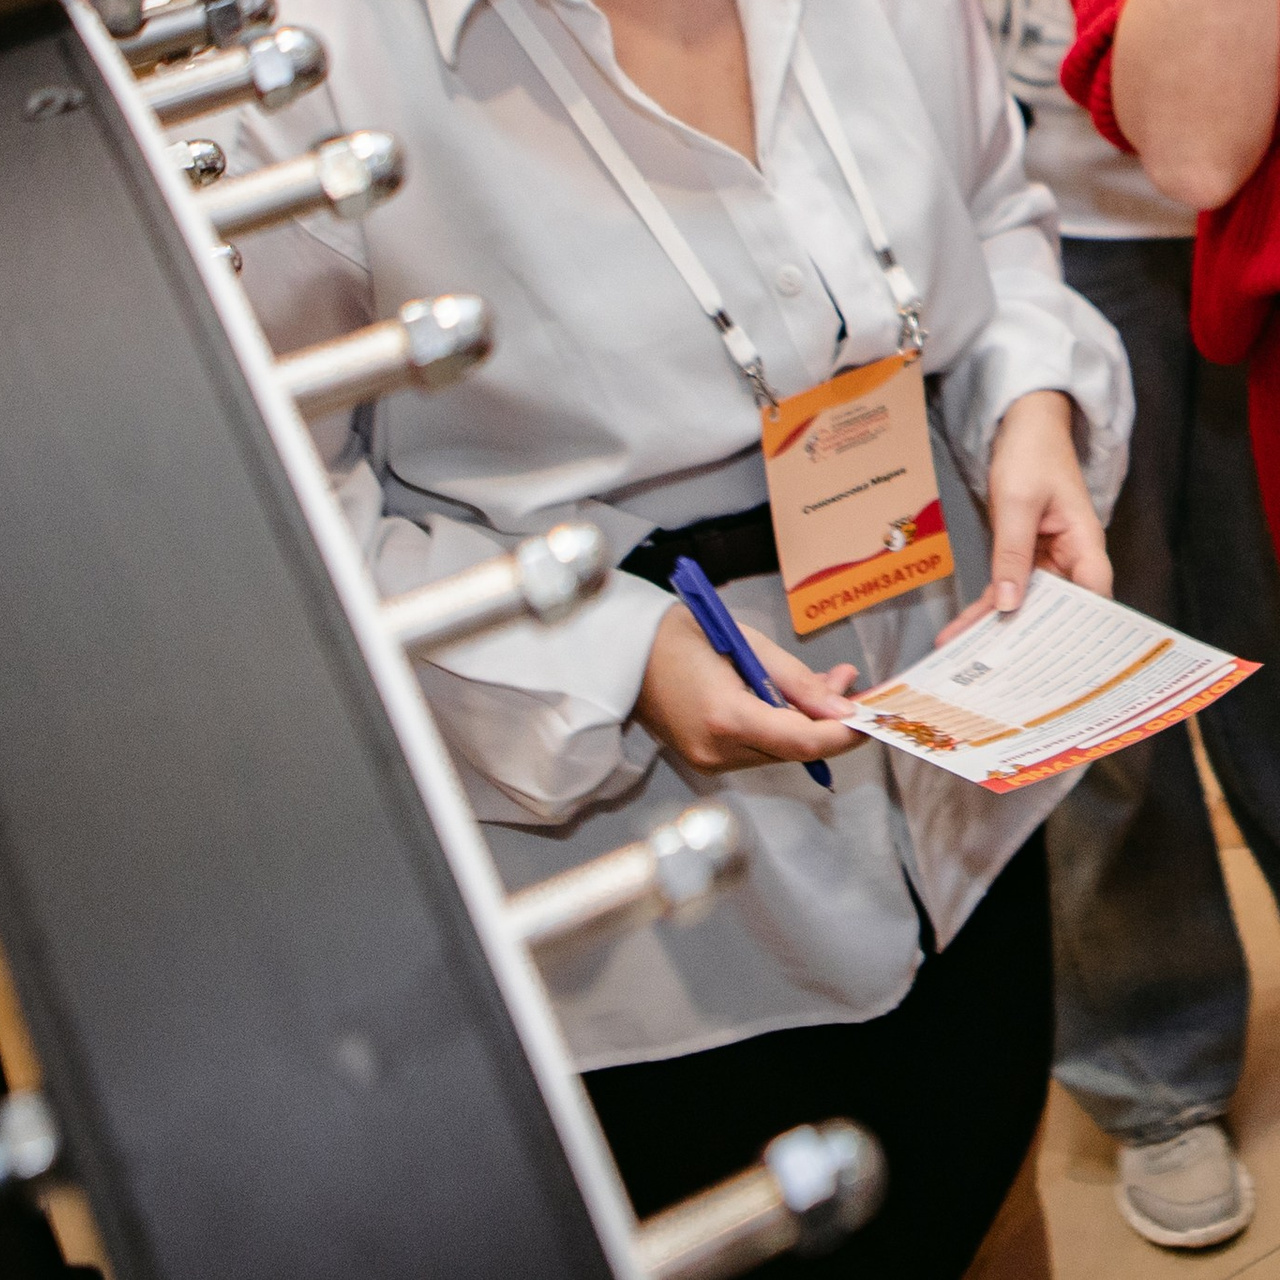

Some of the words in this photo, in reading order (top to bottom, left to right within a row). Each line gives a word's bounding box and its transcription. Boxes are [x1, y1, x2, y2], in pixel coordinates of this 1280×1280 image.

[804, 554, 942, 620] ОРГАНИЗАТОР
[1158, 658, 1212, 695] ПРАВИЛА
[1095, 693, 1154, 727] УЧАСТИЯ
[1145, 670, 1249, 731] КОЛЕСО
[999, 728, 1085, 764] РОЗЫГРЫШЕ
[1003, 730, 1143, 788] ФОРТУНЫ
